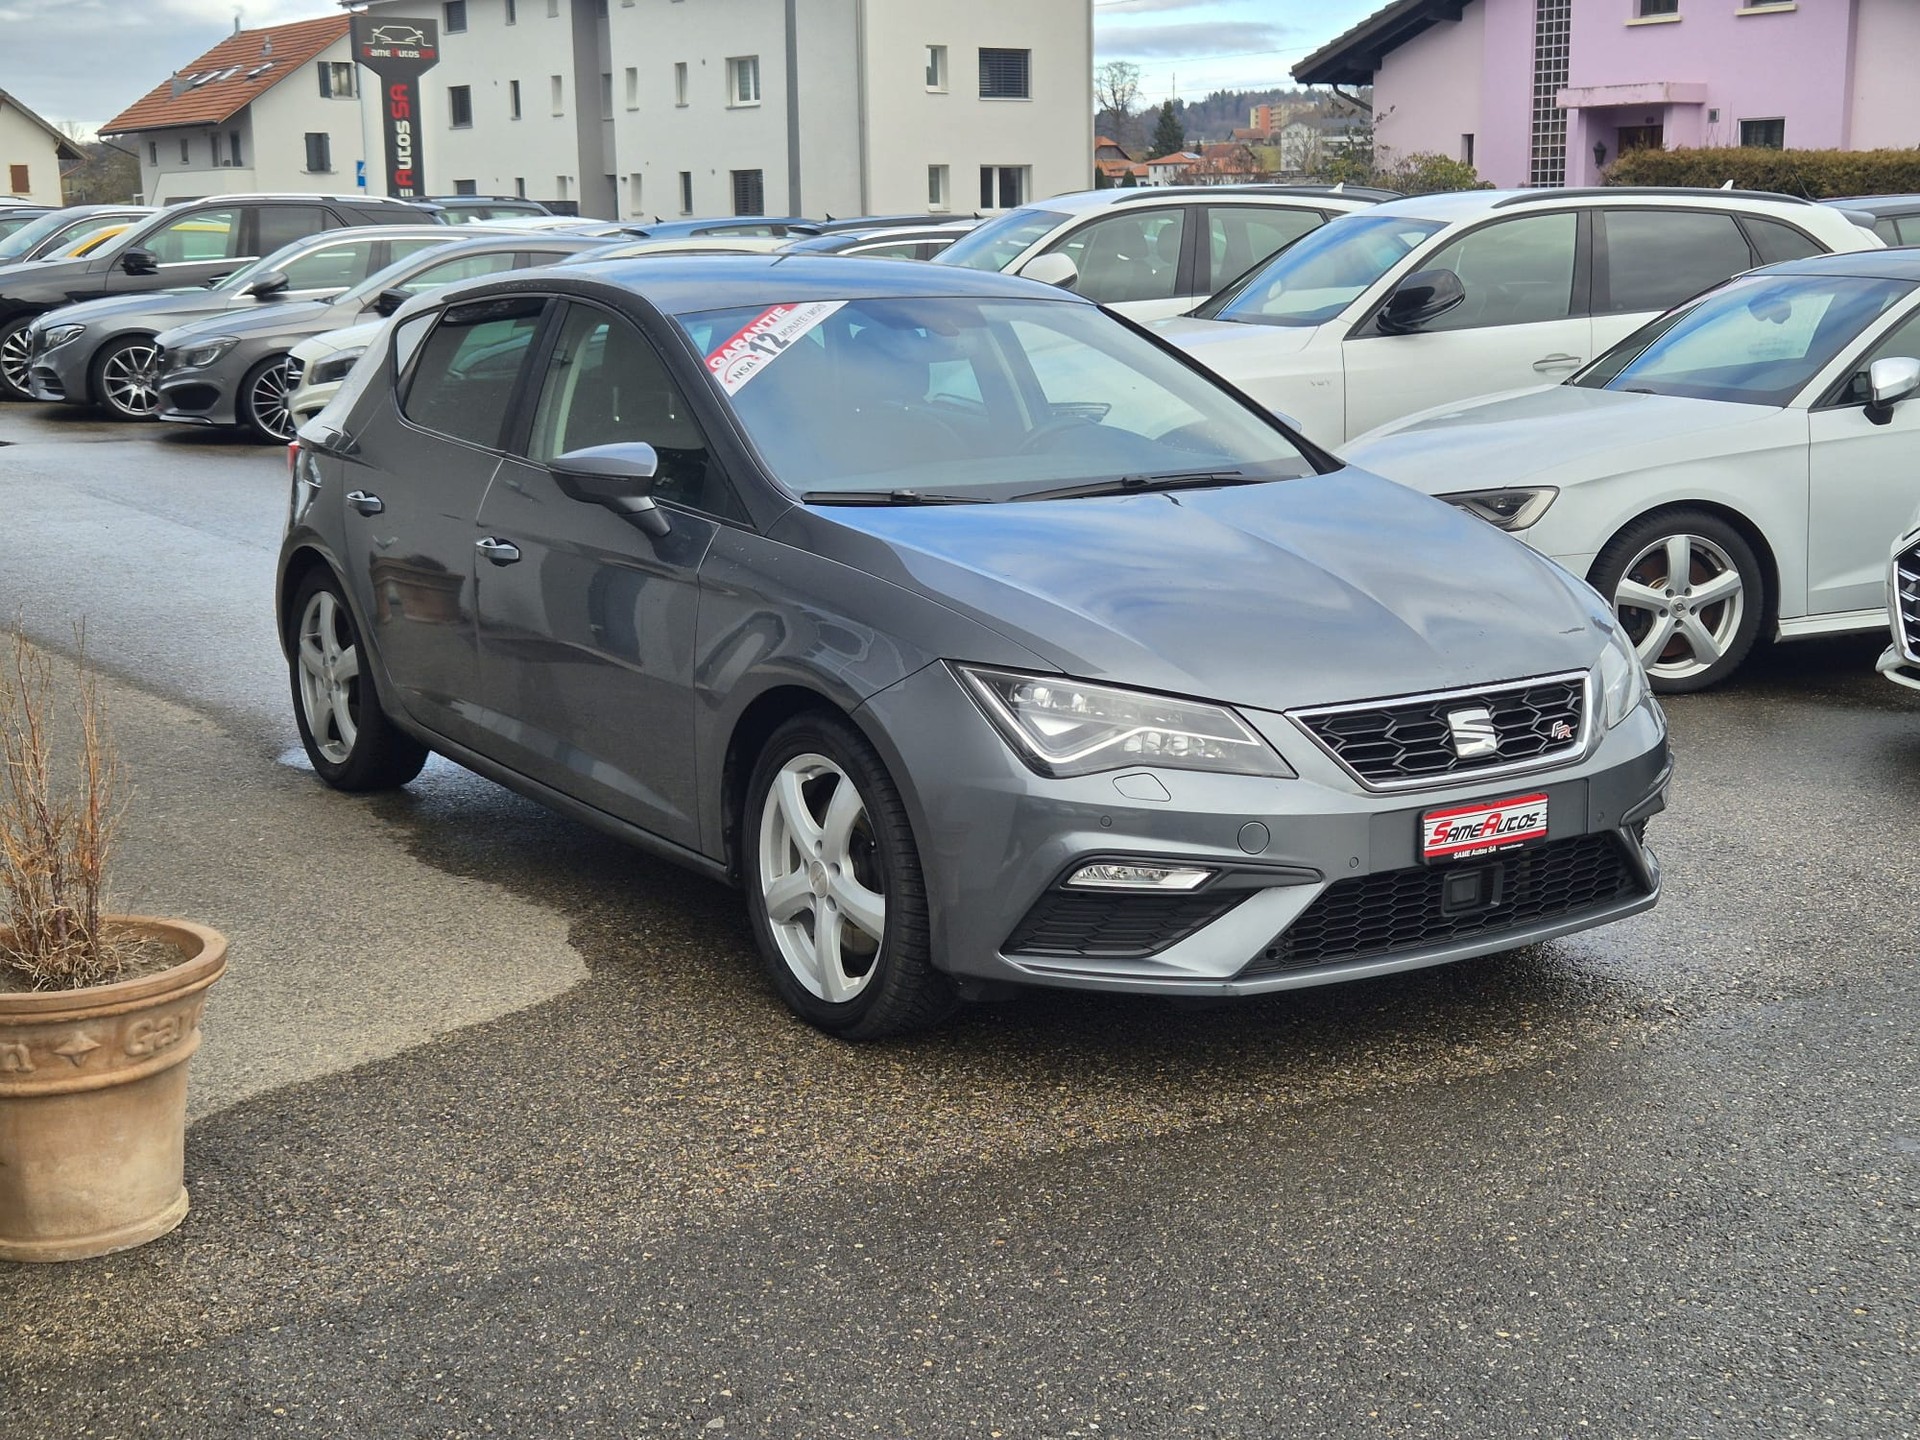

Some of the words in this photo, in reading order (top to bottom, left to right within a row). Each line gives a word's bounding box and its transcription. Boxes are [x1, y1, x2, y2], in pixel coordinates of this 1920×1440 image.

[709, 307, 790, 369] GARANTIE
[748, 332, 791, 356] 12
[733, 361, 756, 379] NSA
